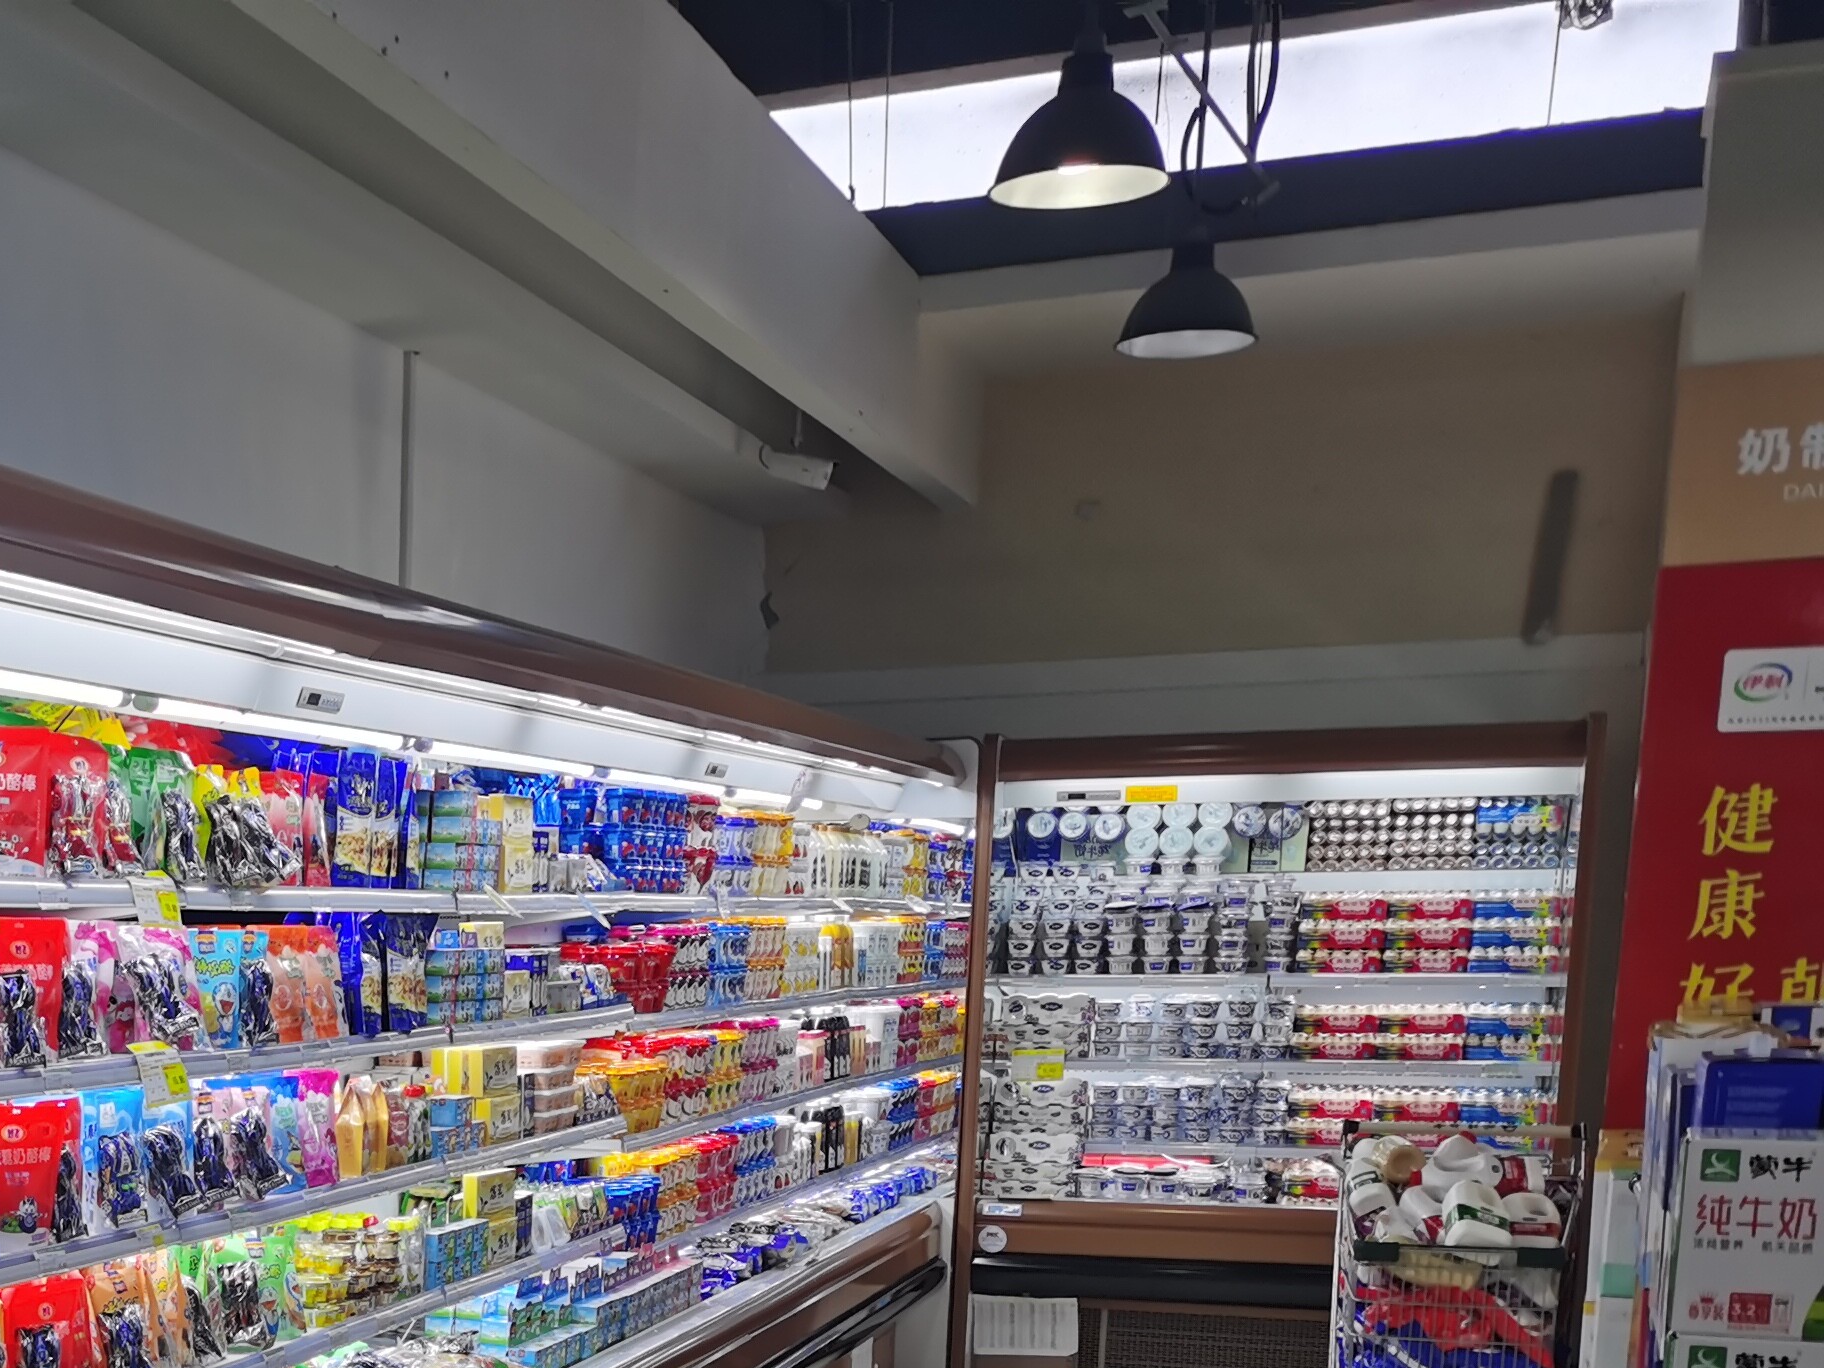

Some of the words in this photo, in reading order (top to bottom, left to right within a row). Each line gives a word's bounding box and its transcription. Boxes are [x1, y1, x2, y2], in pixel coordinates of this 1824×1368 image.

[1749, 1154, 1813, 1183] 蒙牛
[1695, 1194, 1818, 1241] 纯牛奶
